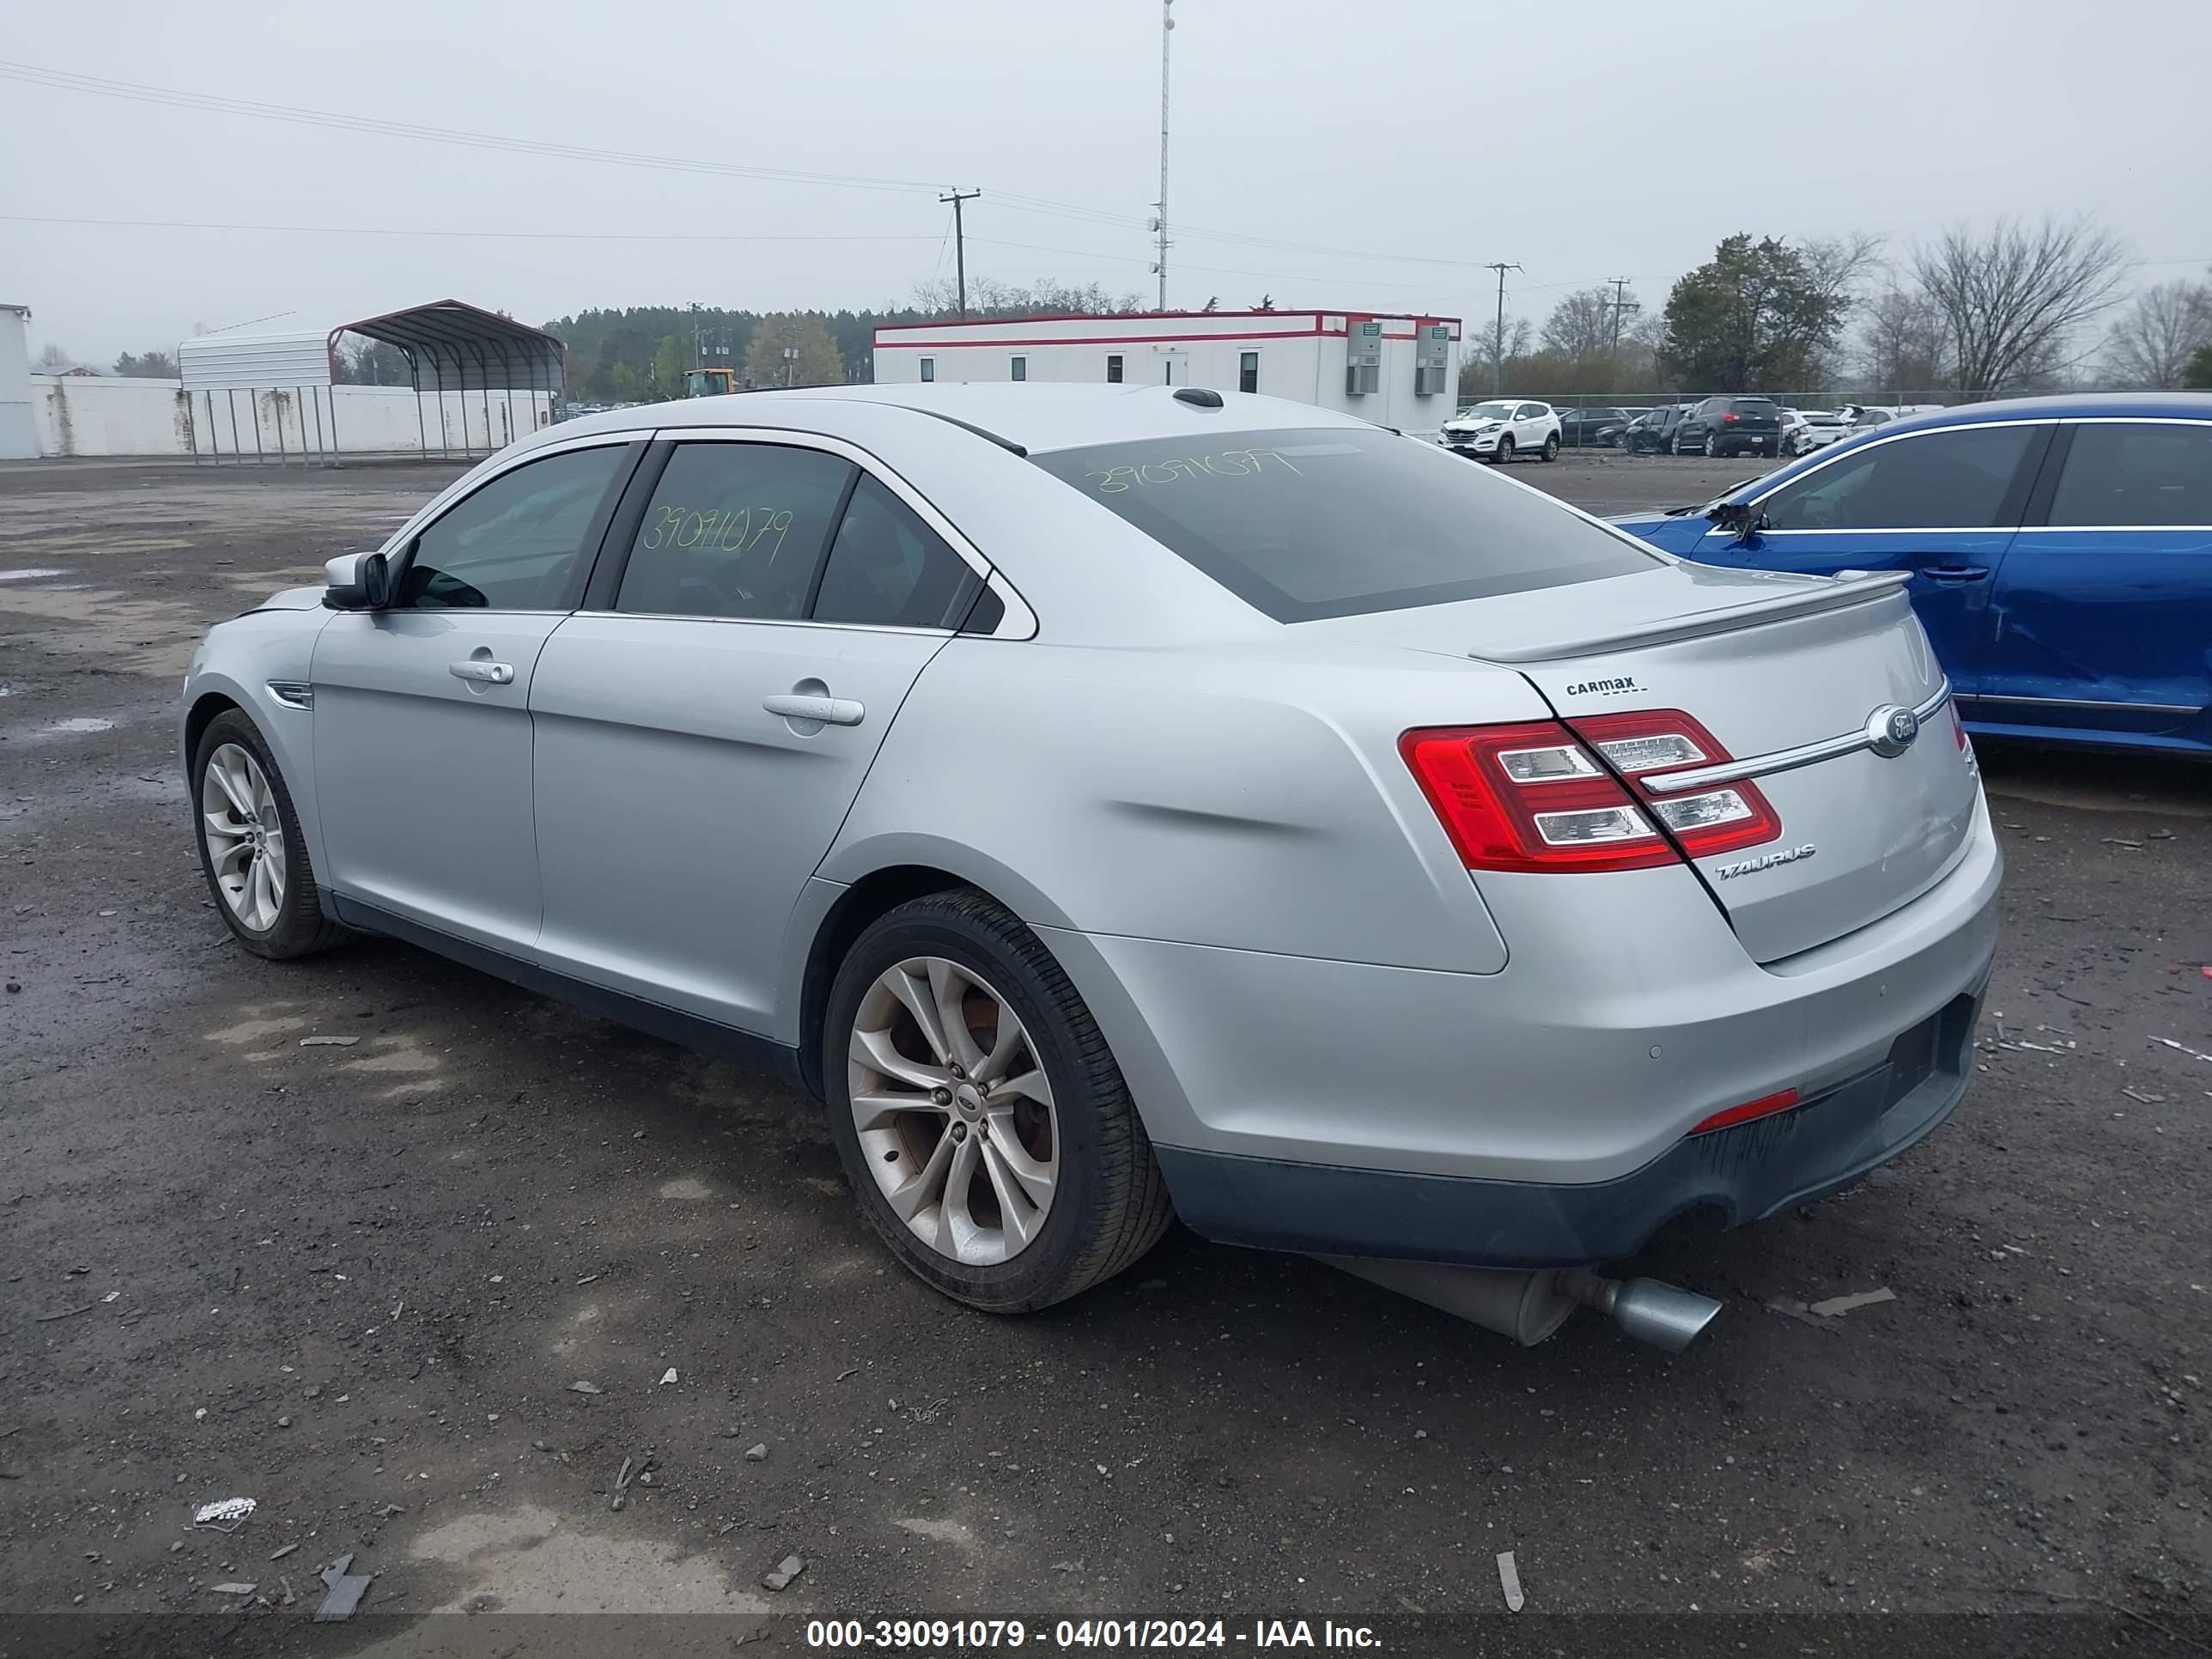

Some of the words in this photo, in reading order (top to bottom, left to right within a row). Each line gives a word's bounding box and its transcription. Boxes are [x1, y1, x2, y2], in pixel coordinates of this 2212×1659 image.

[644, 506, 793, 567] 39091079
[1894, 714, 1916, 739] Ford
[1715, 843, 1817, 880] TAURUS
